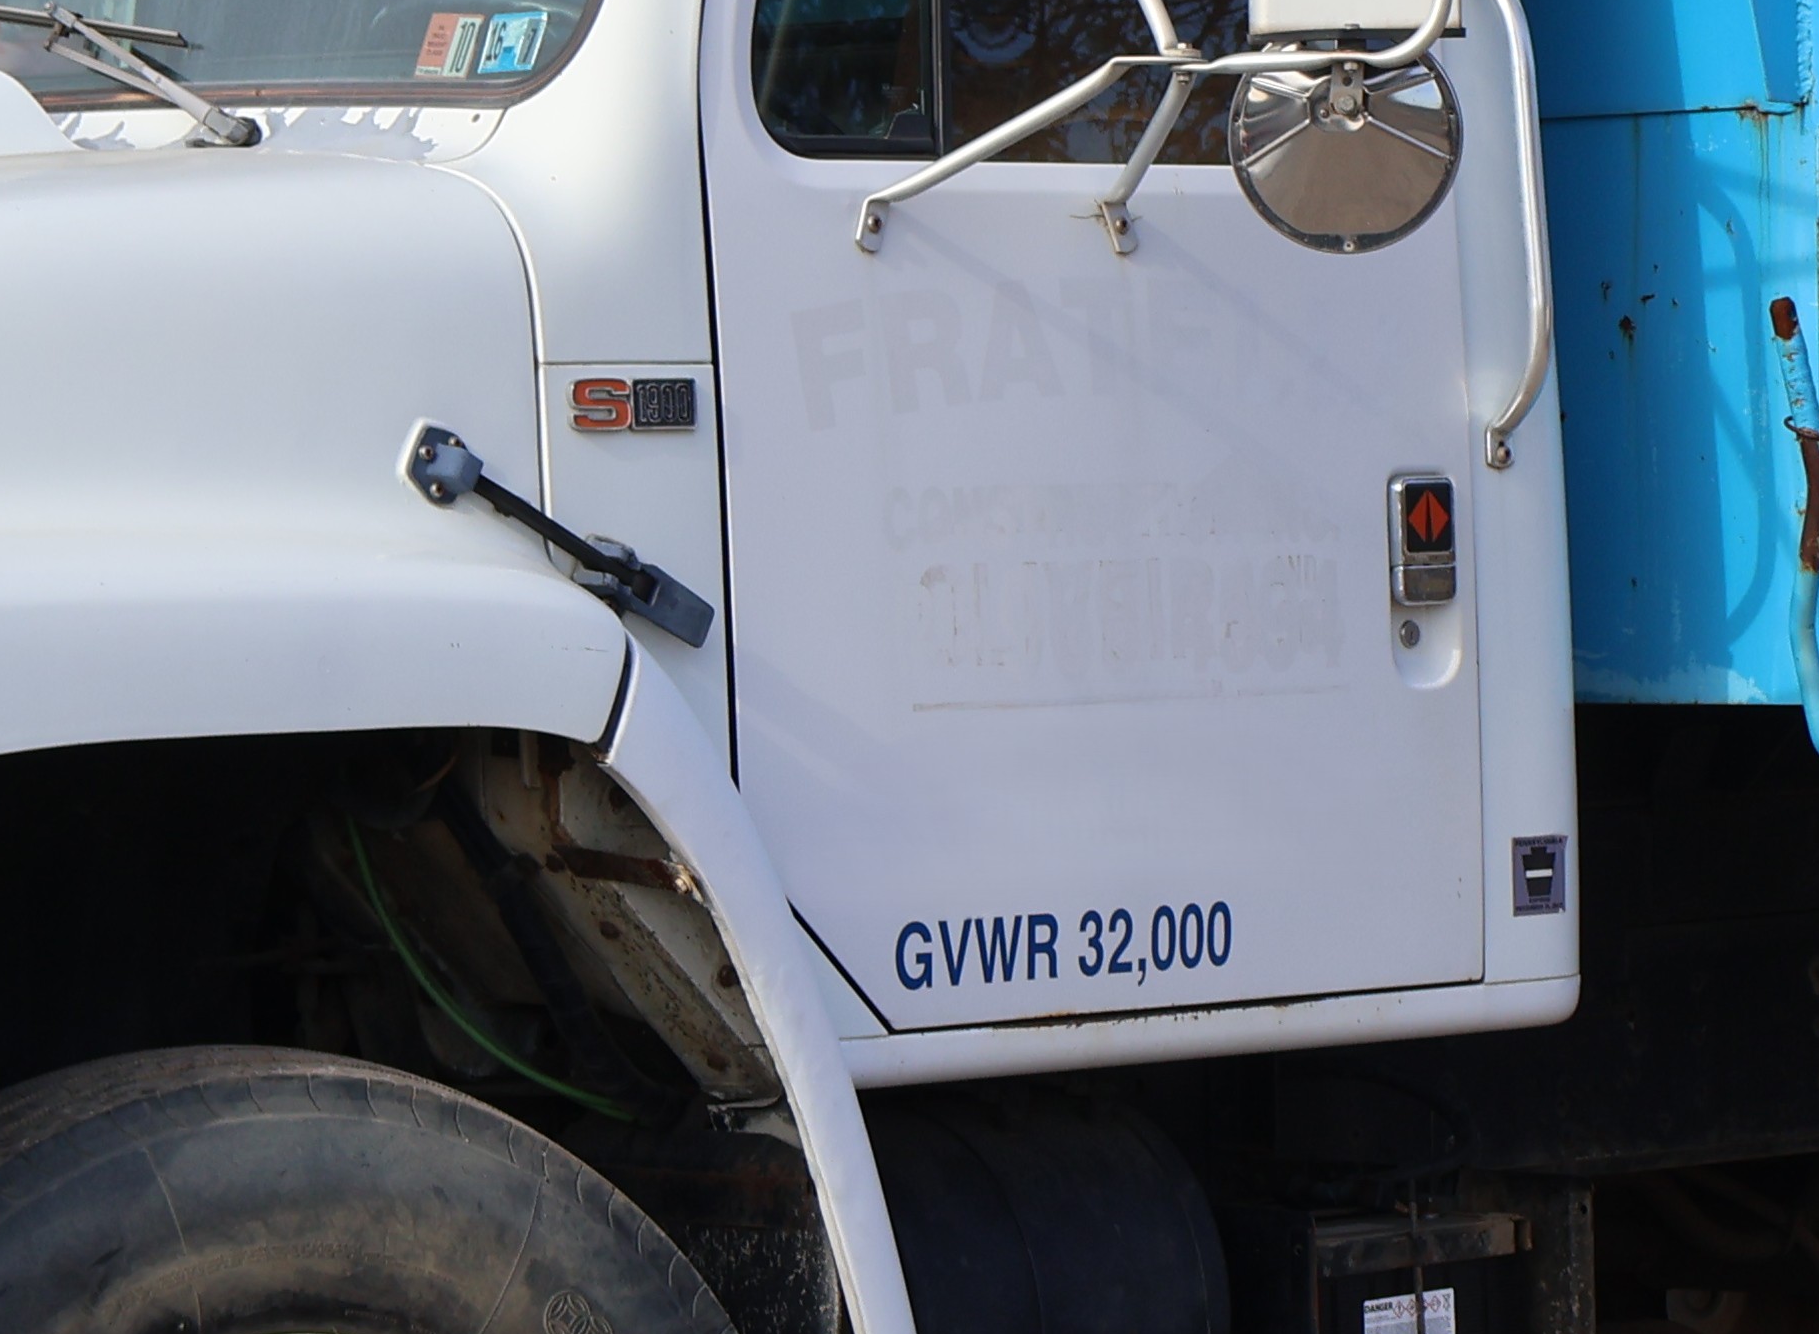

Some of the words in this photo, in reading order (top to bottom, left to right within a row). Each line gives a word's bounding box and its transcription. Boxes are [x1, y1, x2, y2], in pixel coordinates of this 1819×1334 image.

[449, 21, 477, 74] 10
[568, 378, 632, 432] S
[635, 383, 694, 424] 1900
[895, 913, 1059, 991] GVWR
[1078, 900, 1232, 987] 32,000
[1363, 1301, 1393, 1314] DANGER
